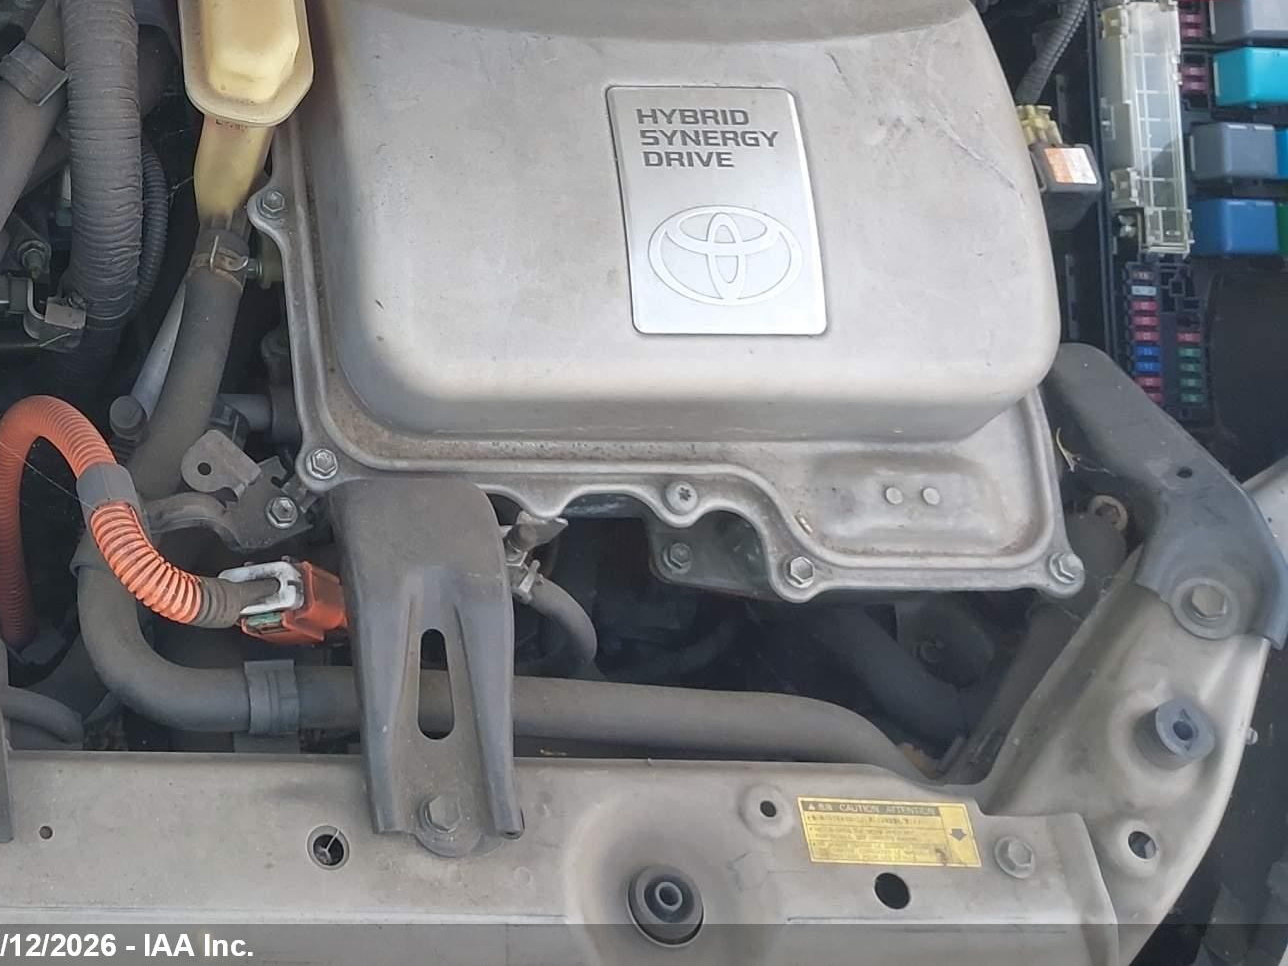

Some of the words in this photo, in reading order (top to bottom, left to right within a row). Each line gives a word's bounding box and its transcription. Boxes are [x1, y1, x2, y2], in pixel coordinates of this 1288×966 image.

[636, 107, 750, 126] HYBRID
[640, 129, 779, 148] SYNERGY
[643, 150, 735, 168] DRIVE
[839, 803, 881, 814] CAUTION
